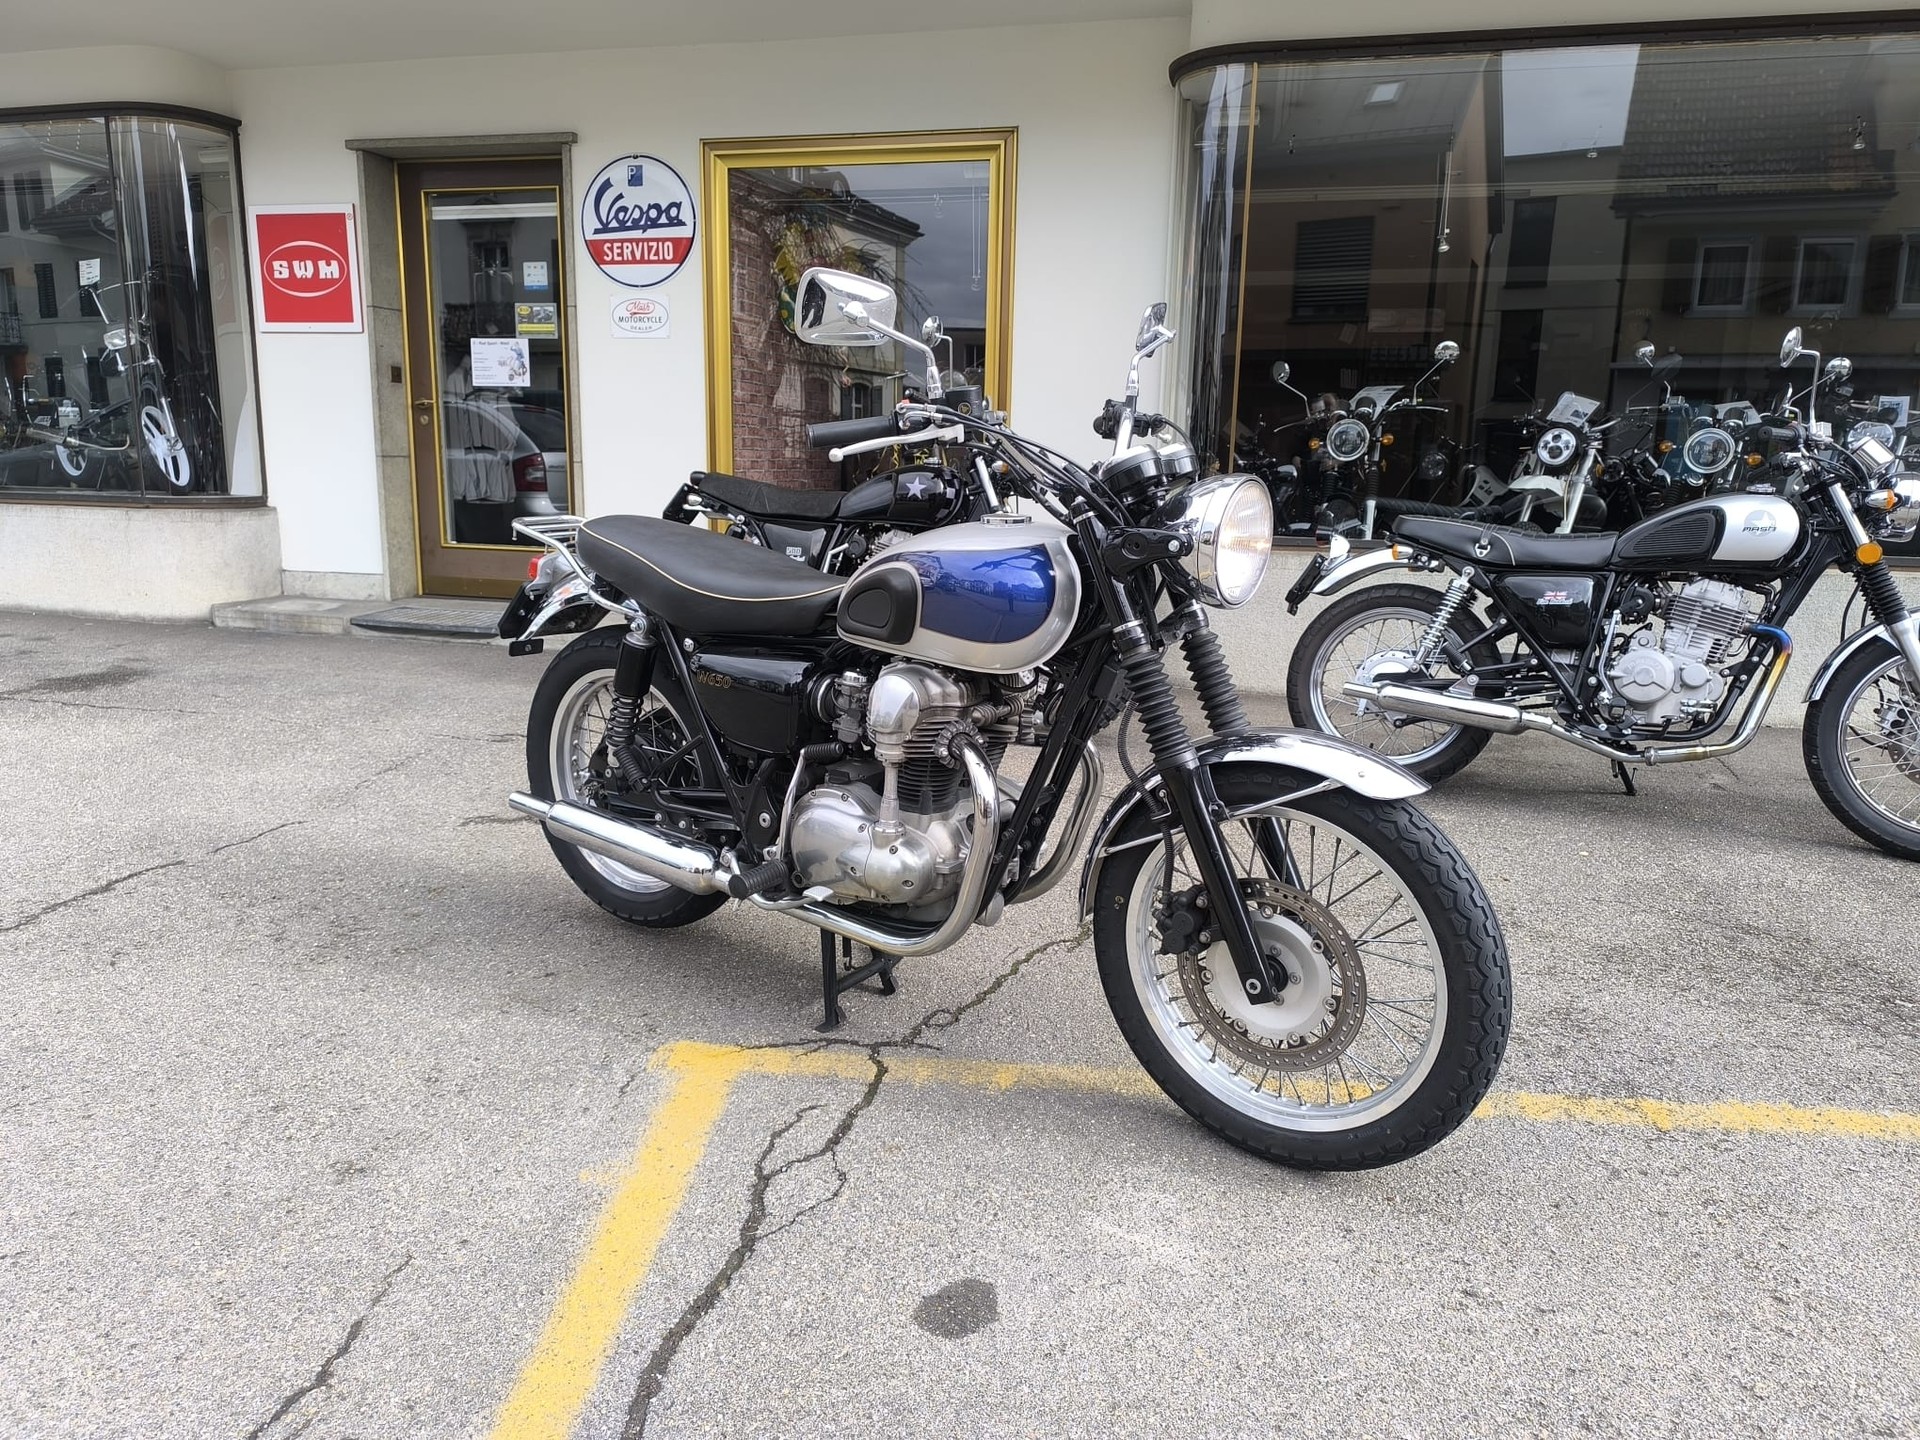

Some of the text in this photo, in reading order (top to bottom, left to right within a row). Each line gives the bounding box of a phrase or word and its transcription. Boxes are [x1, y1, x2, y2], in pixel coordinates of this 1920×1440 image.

[593, 176, 687, 234] Vespa
[603, 241, 673, 261] SERVIZIO
[272, 260, 340, 279] SWM
[697, 670, 731, 688] W650
